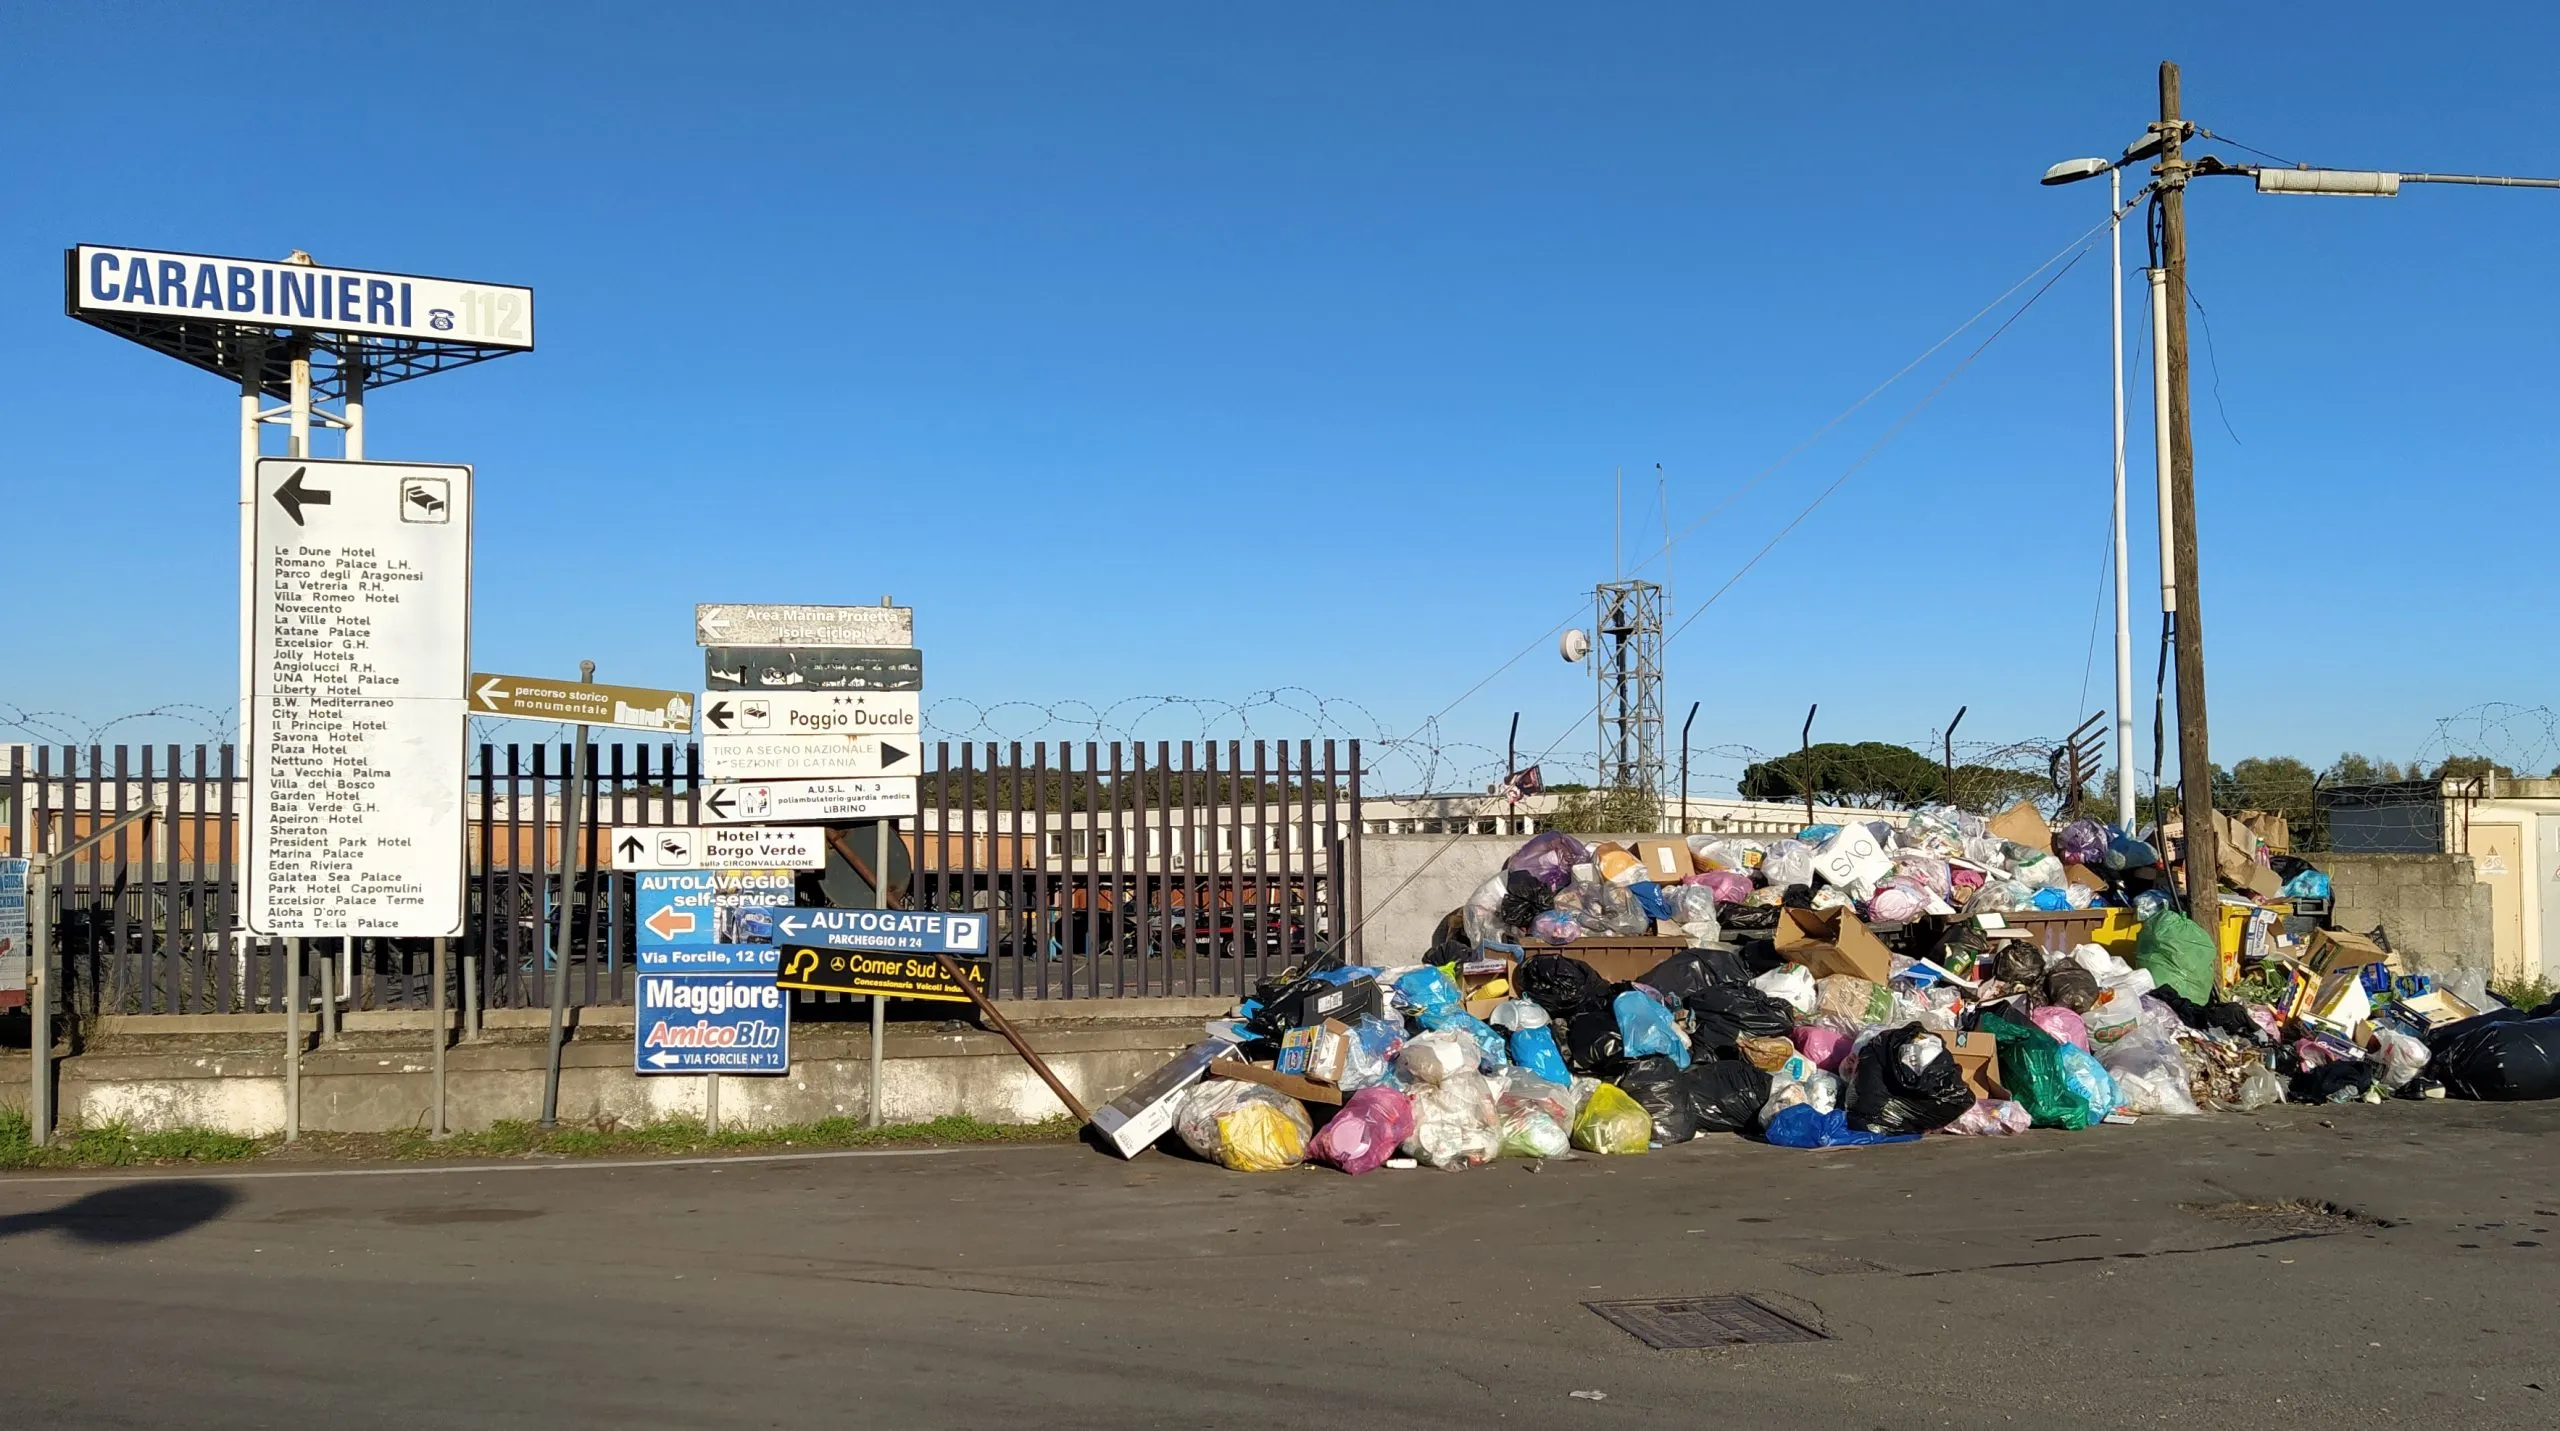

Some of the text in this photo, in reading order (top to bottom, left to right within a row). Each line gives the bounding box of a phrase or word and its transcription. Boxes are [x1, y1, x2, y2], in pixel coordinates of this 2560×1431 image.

[90, 252, 523, 339] CARABINIERI 112
[275, 545, 376, 558] Le Dune Hotel
[274, 556, 325, 568] Romano
[336, 558, 377, 569] Palace
[275, 568, 423, 582] Parco degli Aragonesi
[275, 579, 289, 590] La
[299, 580, 348, 591] Vetreria
[274, 591, 400, 603] Villa Romeo Hotel
[275, 603, 342, 614] Novecento
[274, 614, 371, 626] La Ville Hotel
[746, 610, 898, 623] Area Marina Protetta
[274, 625, 371, 638] Katane Palace
[275, 637, 333, 648] Excelsior
[273, 649, 355, 662] Jolly Hotels
[273, 662, 340, 673] Angiolucci
[273, 672, 400, 685] UNA Hotel Palace
[273, 685, 362, 696] Liberty Hotel
[515, 687, 609, 703] percorso storico
[311, 698, 394, 707] Mediterraneo
[514, 699, 608, 715] monumentale
[272, 708, 343, 721] City Hotel
[790, 709, 914, 730] Poggio Ducale
[291, 720, 343, 732] Principe
[352, 720, 387, 730] Hotel
[272, 732, 364, 742] Savona Hotel
[271, 743, 348, 755] Plaza Hotel
[713, 744, 875, 756] TIRO A SEGNO NAZIONALE
[271, 755, 368, 766] Nettuno Hotel
[787, 759, 799, 768] DI
[803, 758, 857, 768] CATANIA
[271, 767, 391, 778] La Vecchia Palma
[270, 778, 375, 790] Villa del Bosco
[874, 783, 881, 792] 3
[270, 790, 360, 801] Garden Hotel
[270, 802, 298, 812] Baia
[308, 802, 343, 812] Verde
[823, 804, 866, 814] LIBRINO
[269, 814, 363, 825] Apeiron Hotel
[270, 825, 327, 835] Sheraton
[717, 831, 759, 841] Hotel
[269, 837, 411, 847] President Park Hotel
[269, 848, 364, 859] Marina Palace
[707, 844, 807, 858] Borgo Verde
[269, 860, 353, 870] Eden Riviera
[268, 872, 402, 882] Galatea Sea Palace
[642, 876, 789, 890] AUTOLAVAGGIO
[268, 883, 422, 895] Park Hotel Capomulini
[268, 895, 424, 905] Excelsior Palace Terme
[674, 892, 789, 907] self-service
[267, 907, 303, 917] Aloha
[268, 918, 304, 929] Santa
[358, 918, 399, 928] Palace
[811, 911, 972, 944] AUTOGATE P
[828, 934, 922, 948] PARCHEGGIO H 24
[642, 952, 670, 964] Via
[672, 951, 731, 964] Forcile,
[736, 951, 754, 962] 12
[850, 955, 902, 976] Comer
[905, 959, 936, 978] Sud
[854, 977, 913, 989] Concessionaria
[916, 981, 942, 992] Veicoli
[646, 979, 779, 1015] Maggiore
[645, 1019, 780, 1048] AmicoBlu
[683, 1053, 703, 1065] VIA
[705, 1053, 748, 1064] FORCILE
[766, 1053, 779, 1064] 12
